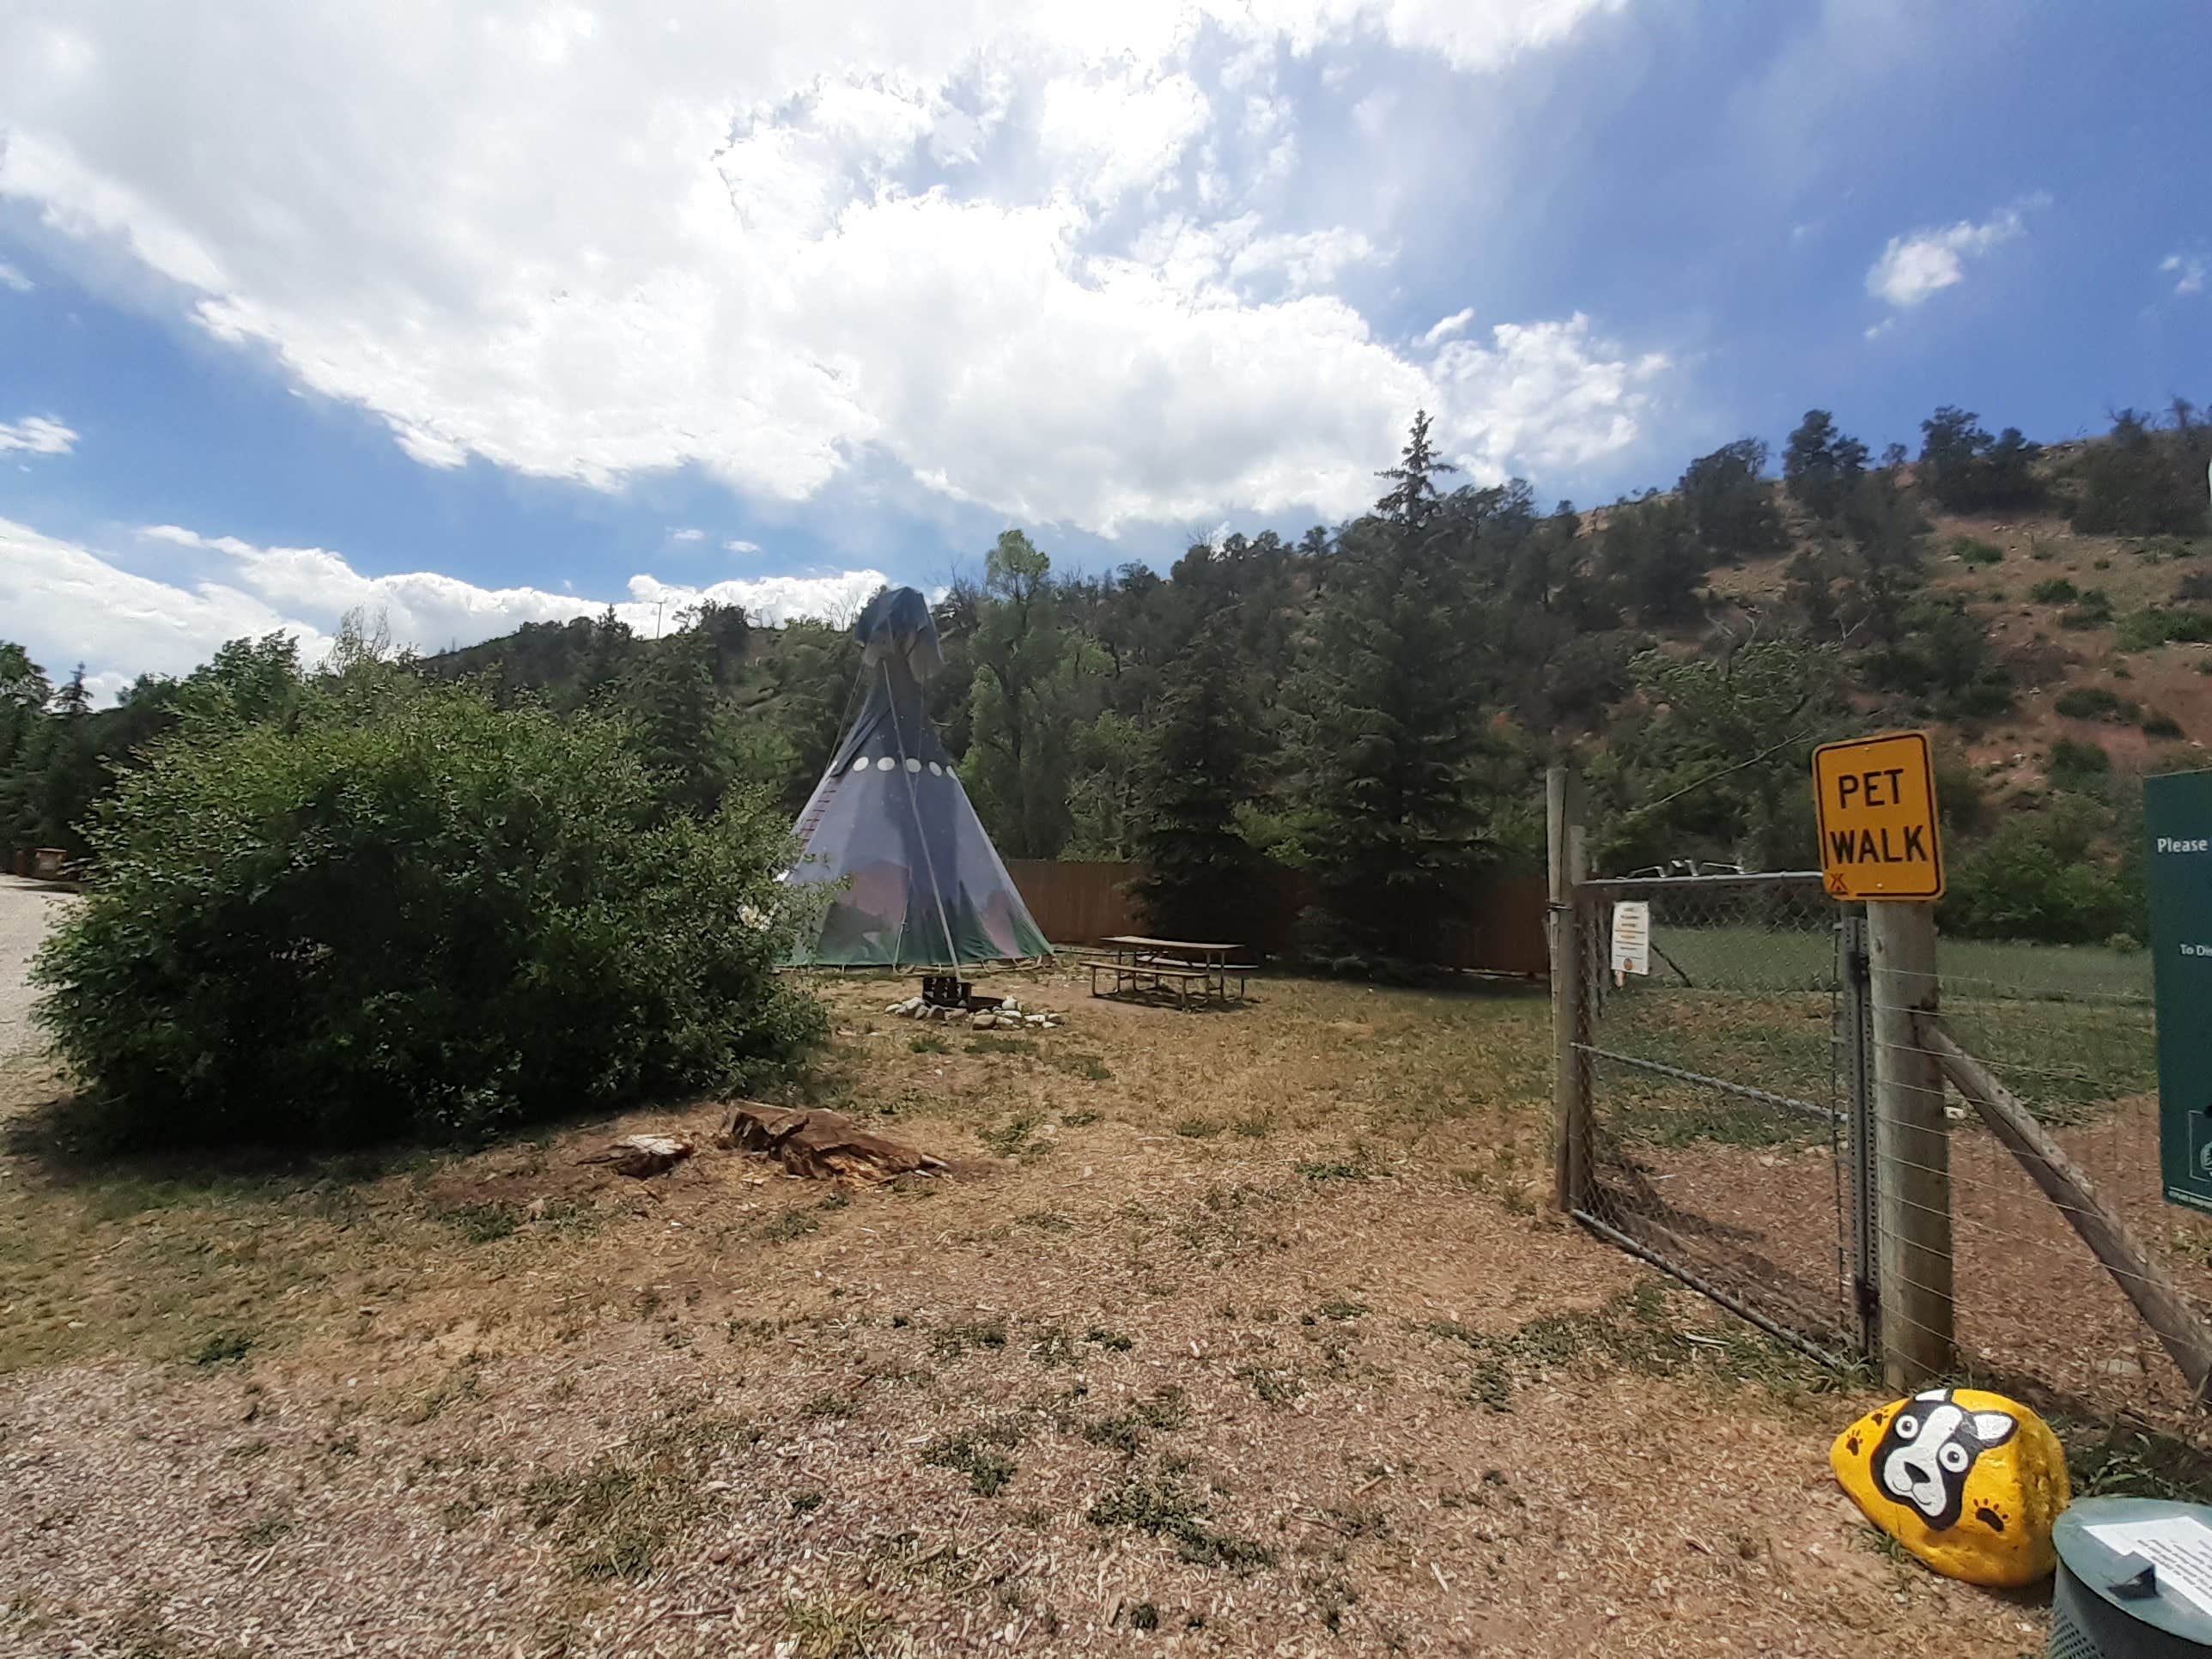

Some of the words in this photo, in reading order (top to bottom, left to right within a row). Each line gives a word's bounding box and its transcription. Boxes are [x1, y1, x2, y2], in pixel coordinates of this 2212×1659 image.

[1838, 769, 1904, 809] PET
[1830, 825, 1927, 864] WALK
[2157, 836, 2209, 853] Please
[2180, 944, 2194, 955] To
